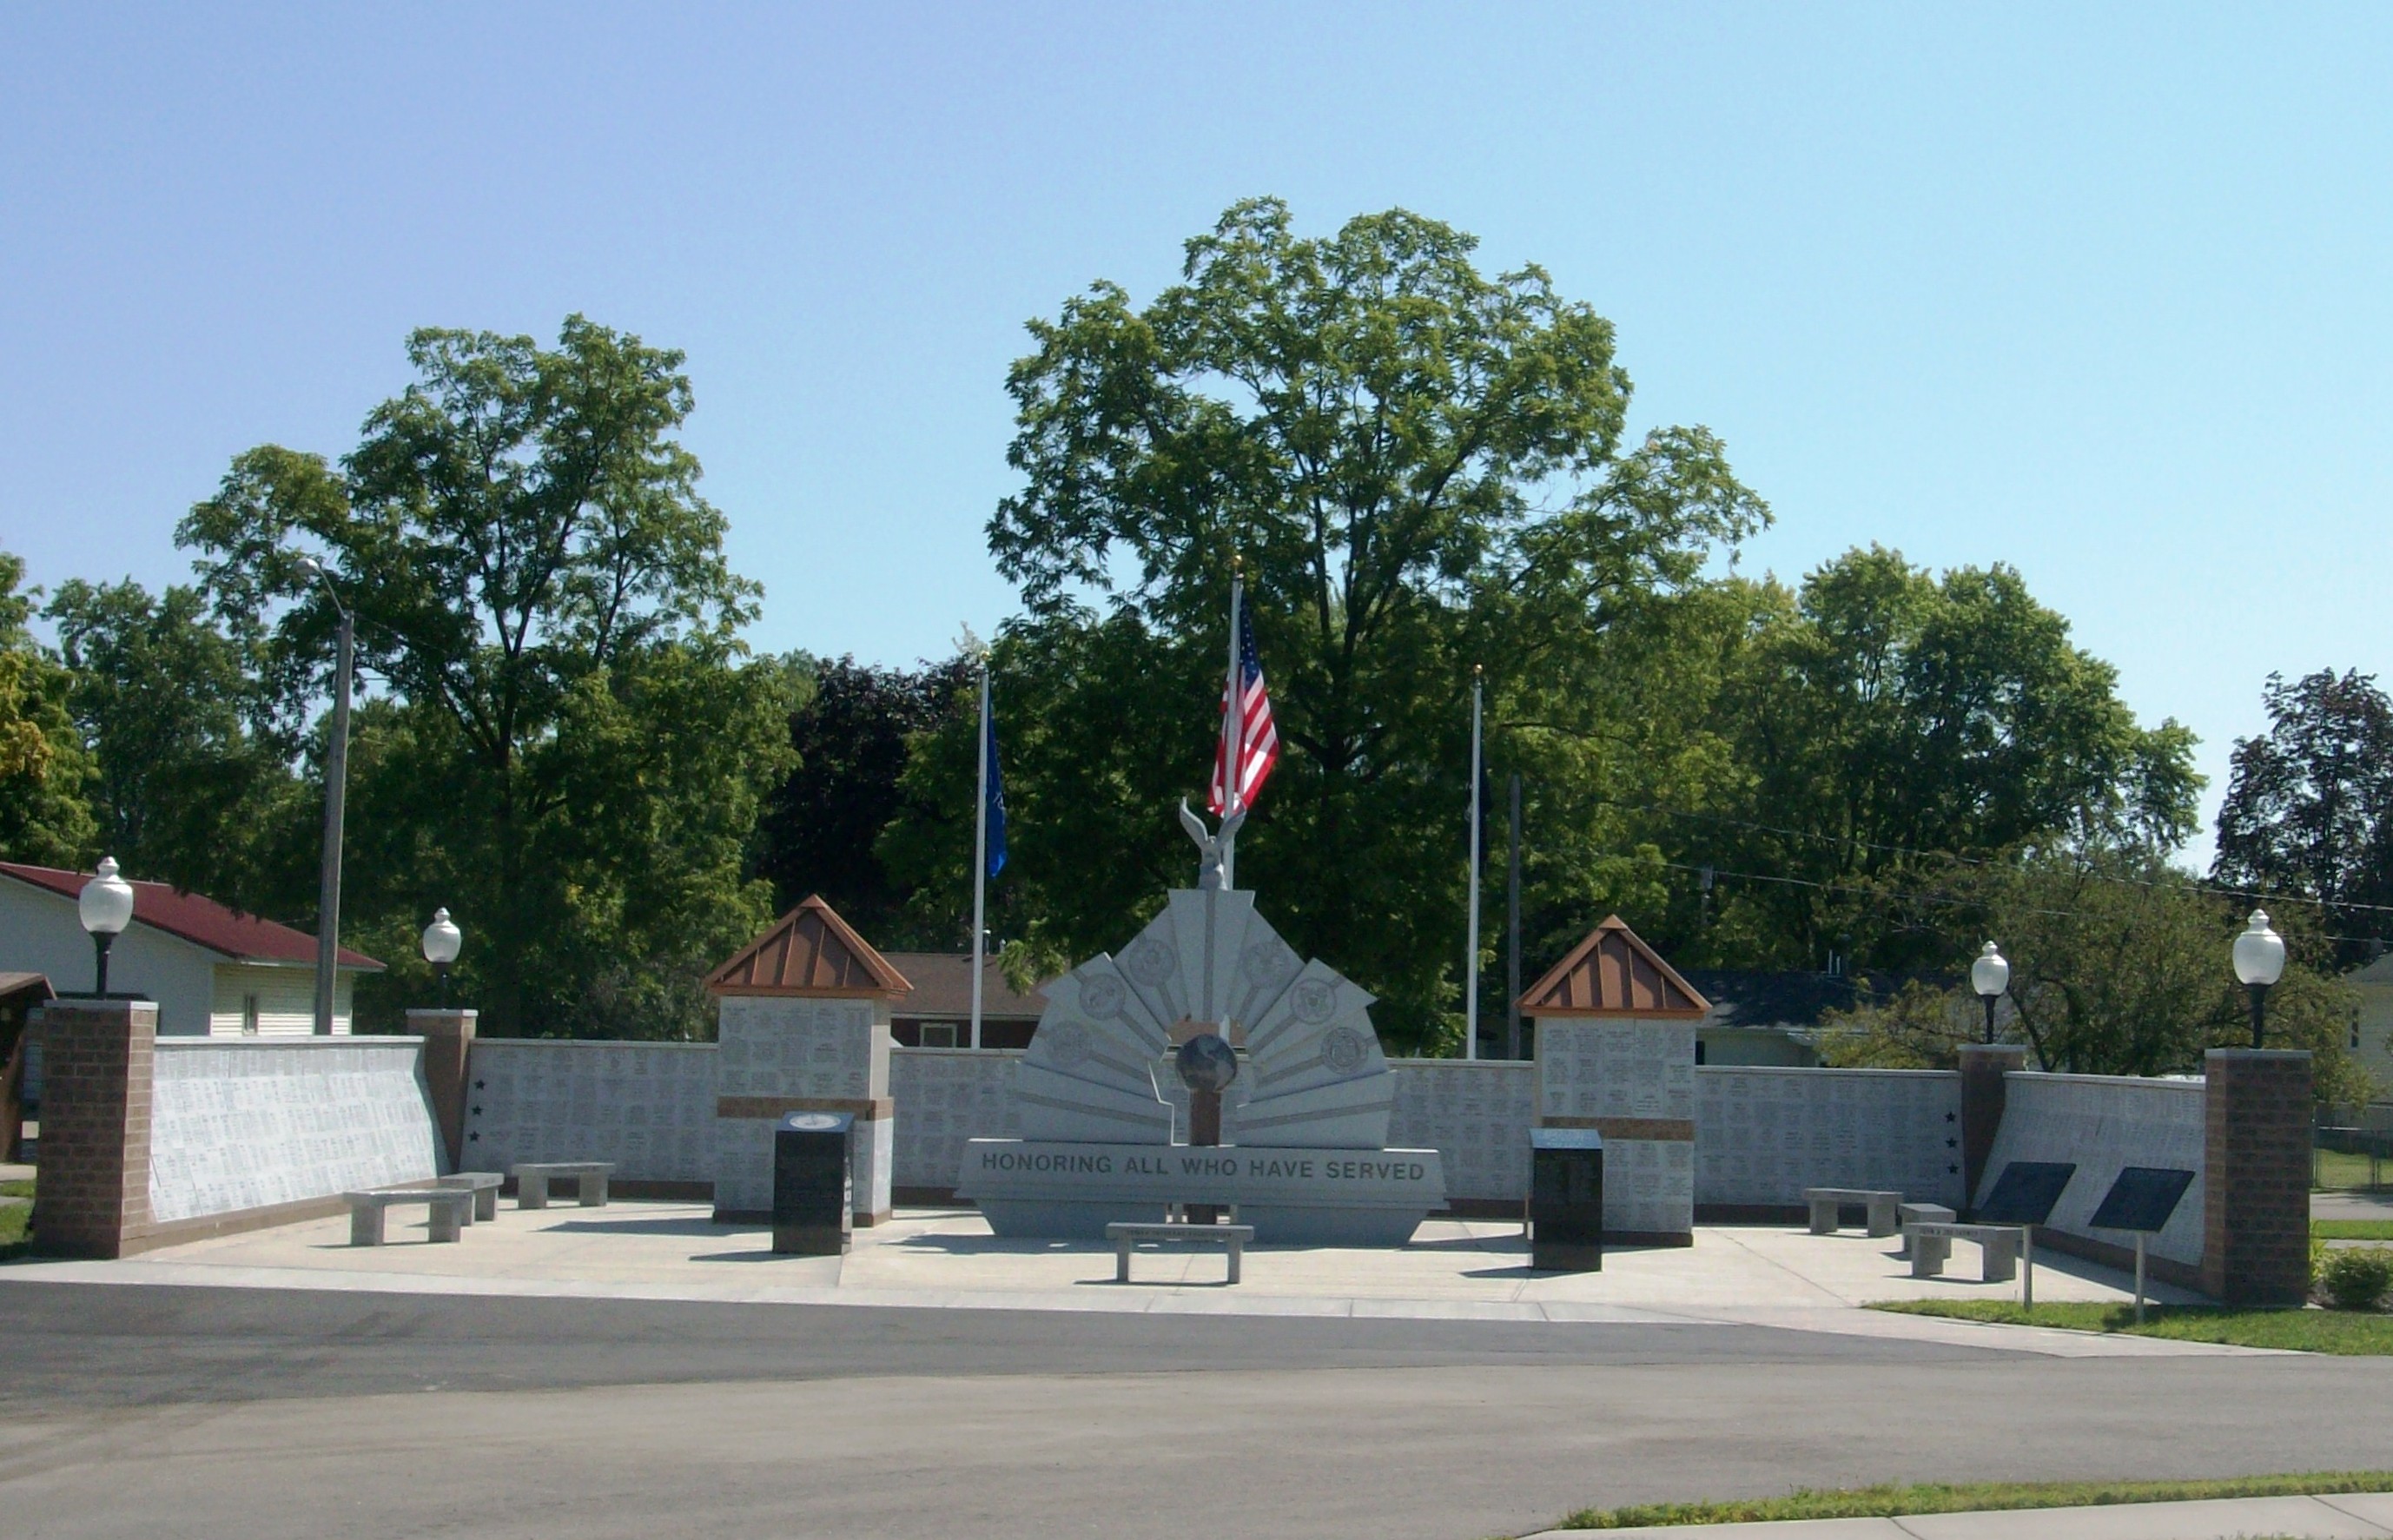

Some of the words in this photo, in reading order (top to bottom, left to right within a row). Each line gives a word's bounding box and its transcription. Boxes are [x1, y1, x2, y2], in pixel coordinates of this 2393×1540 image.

[982, 1153, 1112, 1173] HONORING
[1124, 1158, 1169, 1175] ALL
[1181, 1158, 1238, 1176] WHO
[1250, 1160, 1314, 1177] HAVE
[1326, 1162, 1425, 1180] SERVED
